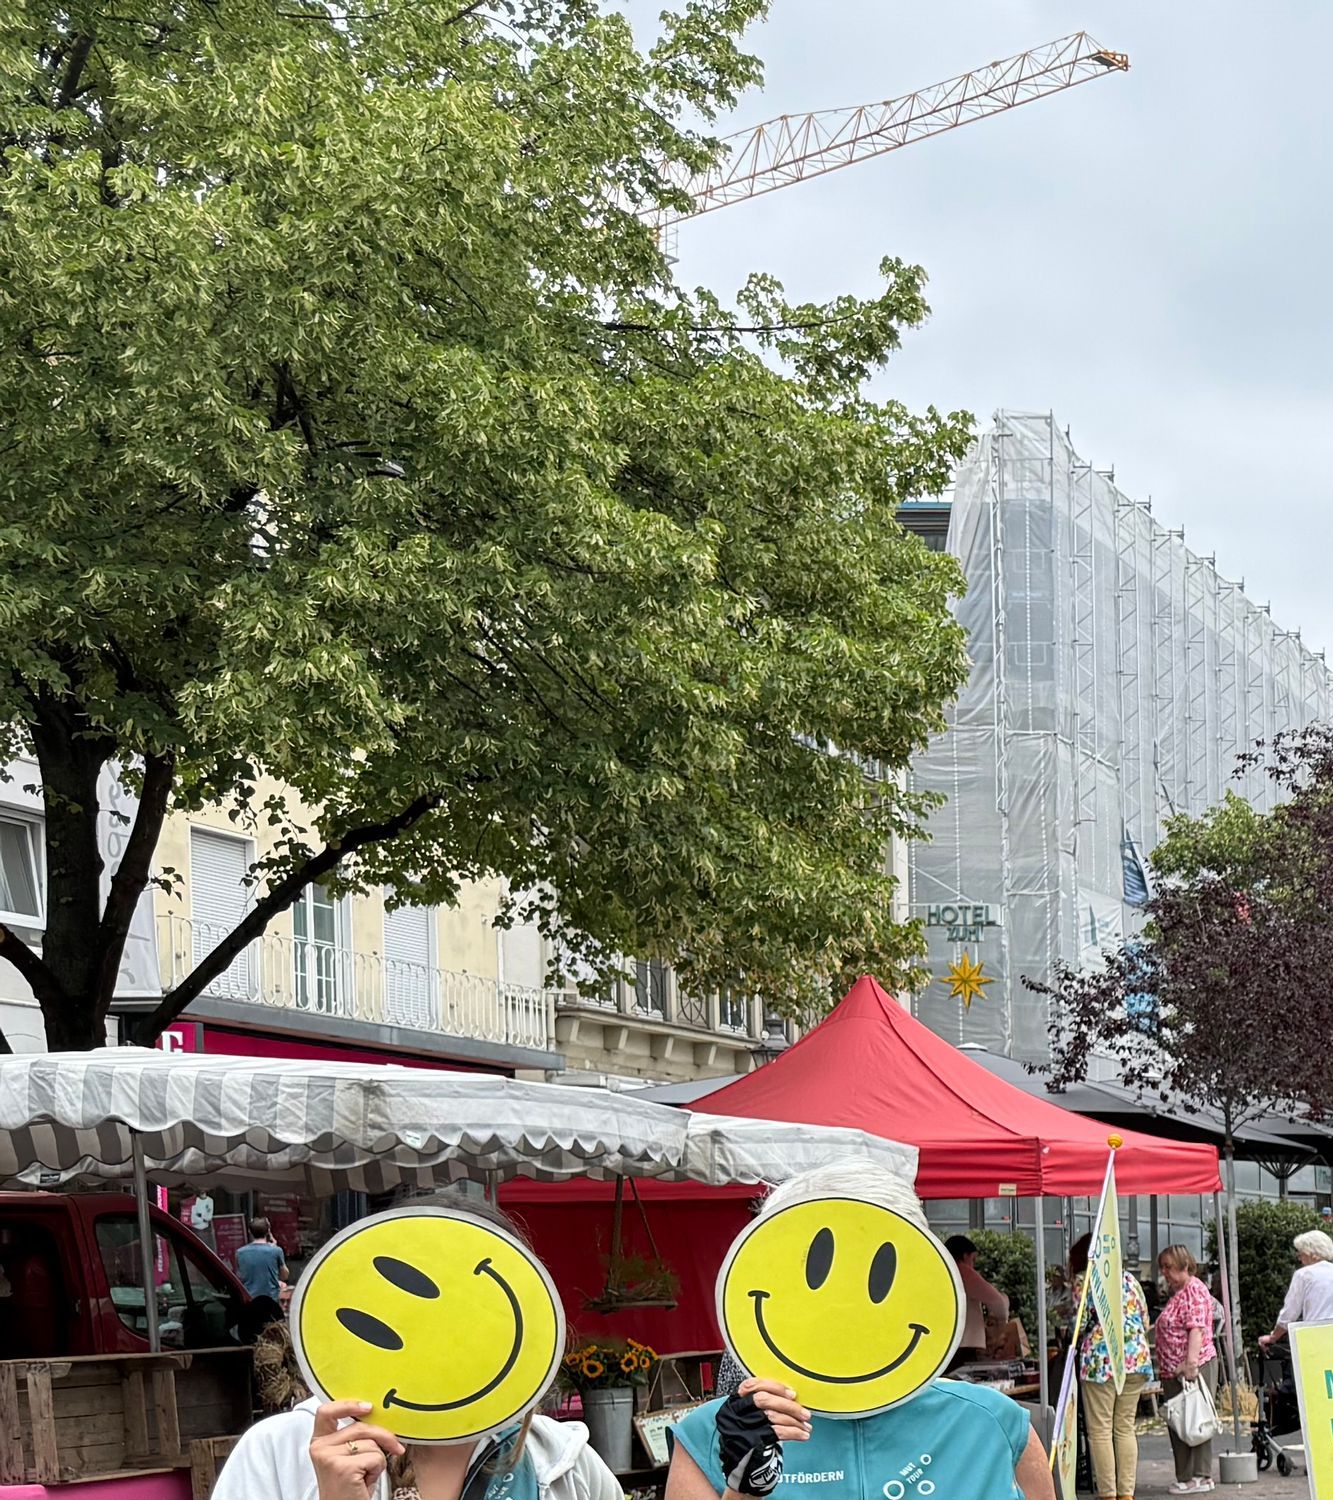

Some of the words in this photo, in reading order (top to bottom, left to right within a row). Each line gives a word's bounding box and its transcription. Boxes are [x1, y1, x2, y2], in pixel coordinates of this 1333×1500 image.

[928, 905, 996, 926] HOTEL
[899, 1462, 917, 1477] MUT
[907, 1468, 924, 1484] TOUR
